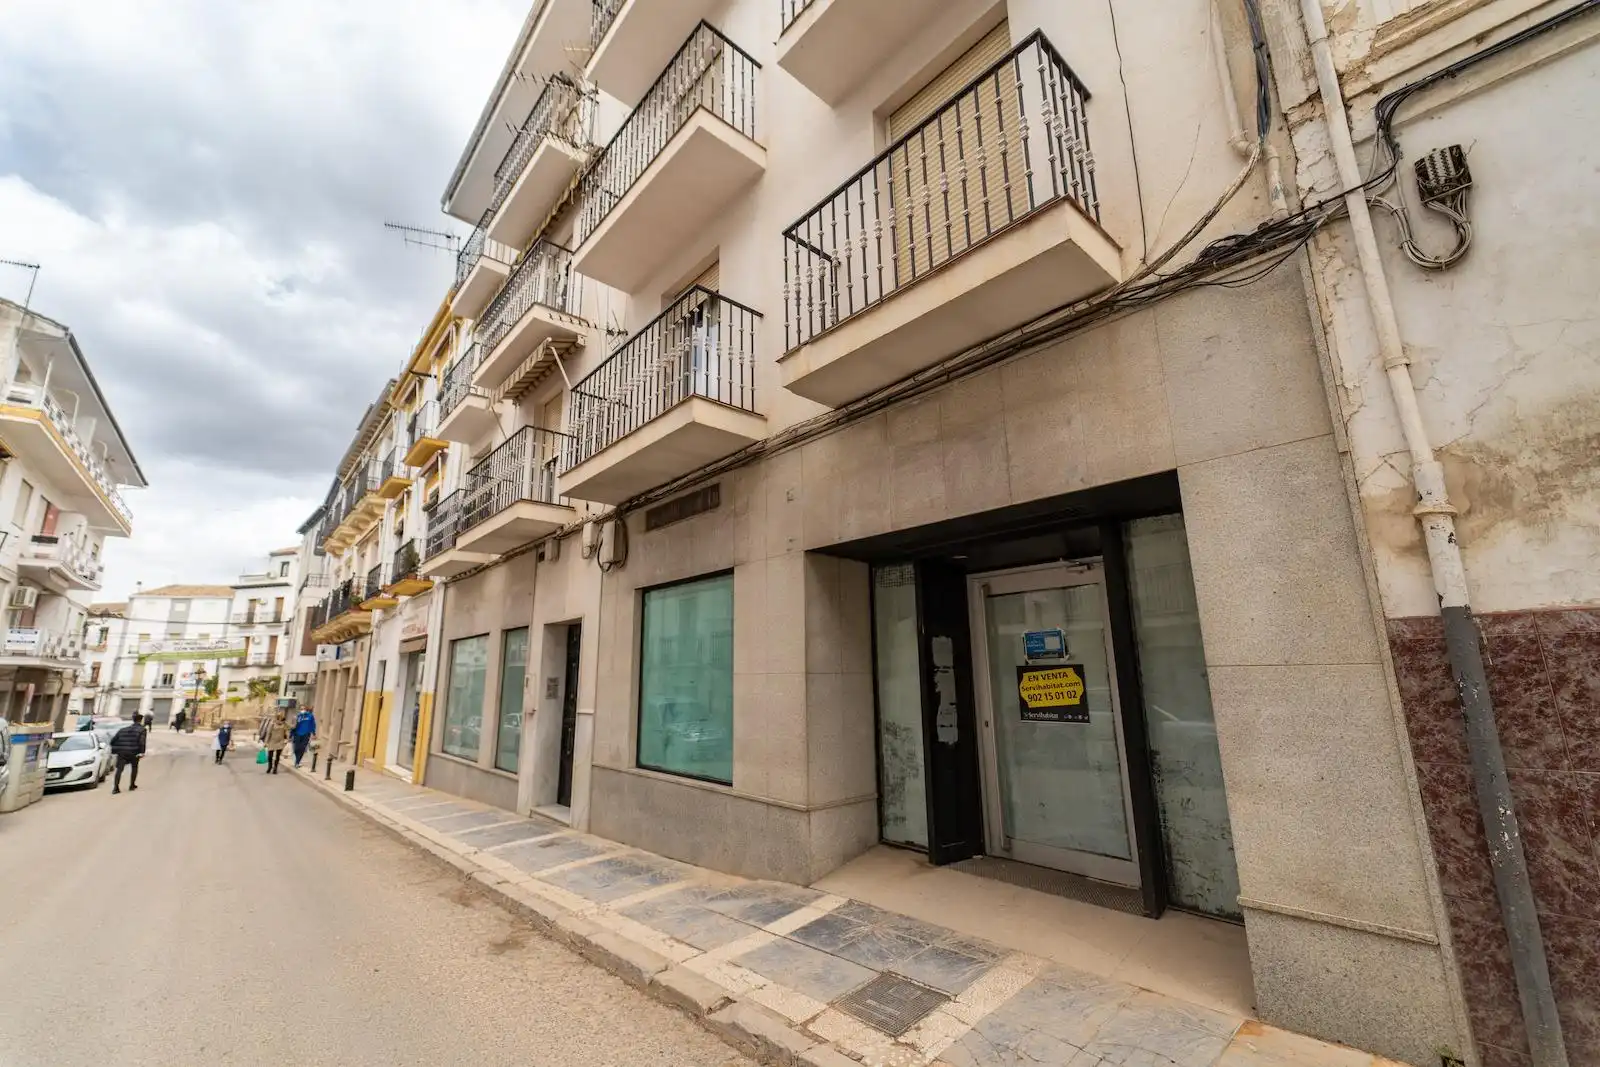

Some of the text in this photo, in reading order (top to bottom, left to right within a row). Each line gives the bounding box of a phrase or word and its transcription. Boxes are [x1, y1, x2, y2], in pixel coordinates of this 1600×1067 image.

[1041, 672, 1069, 681] VENTA
[1021, 681, 1081, 692] Servihabitat.com
[1027, 690, 1078, 702] 902 15 01 02
